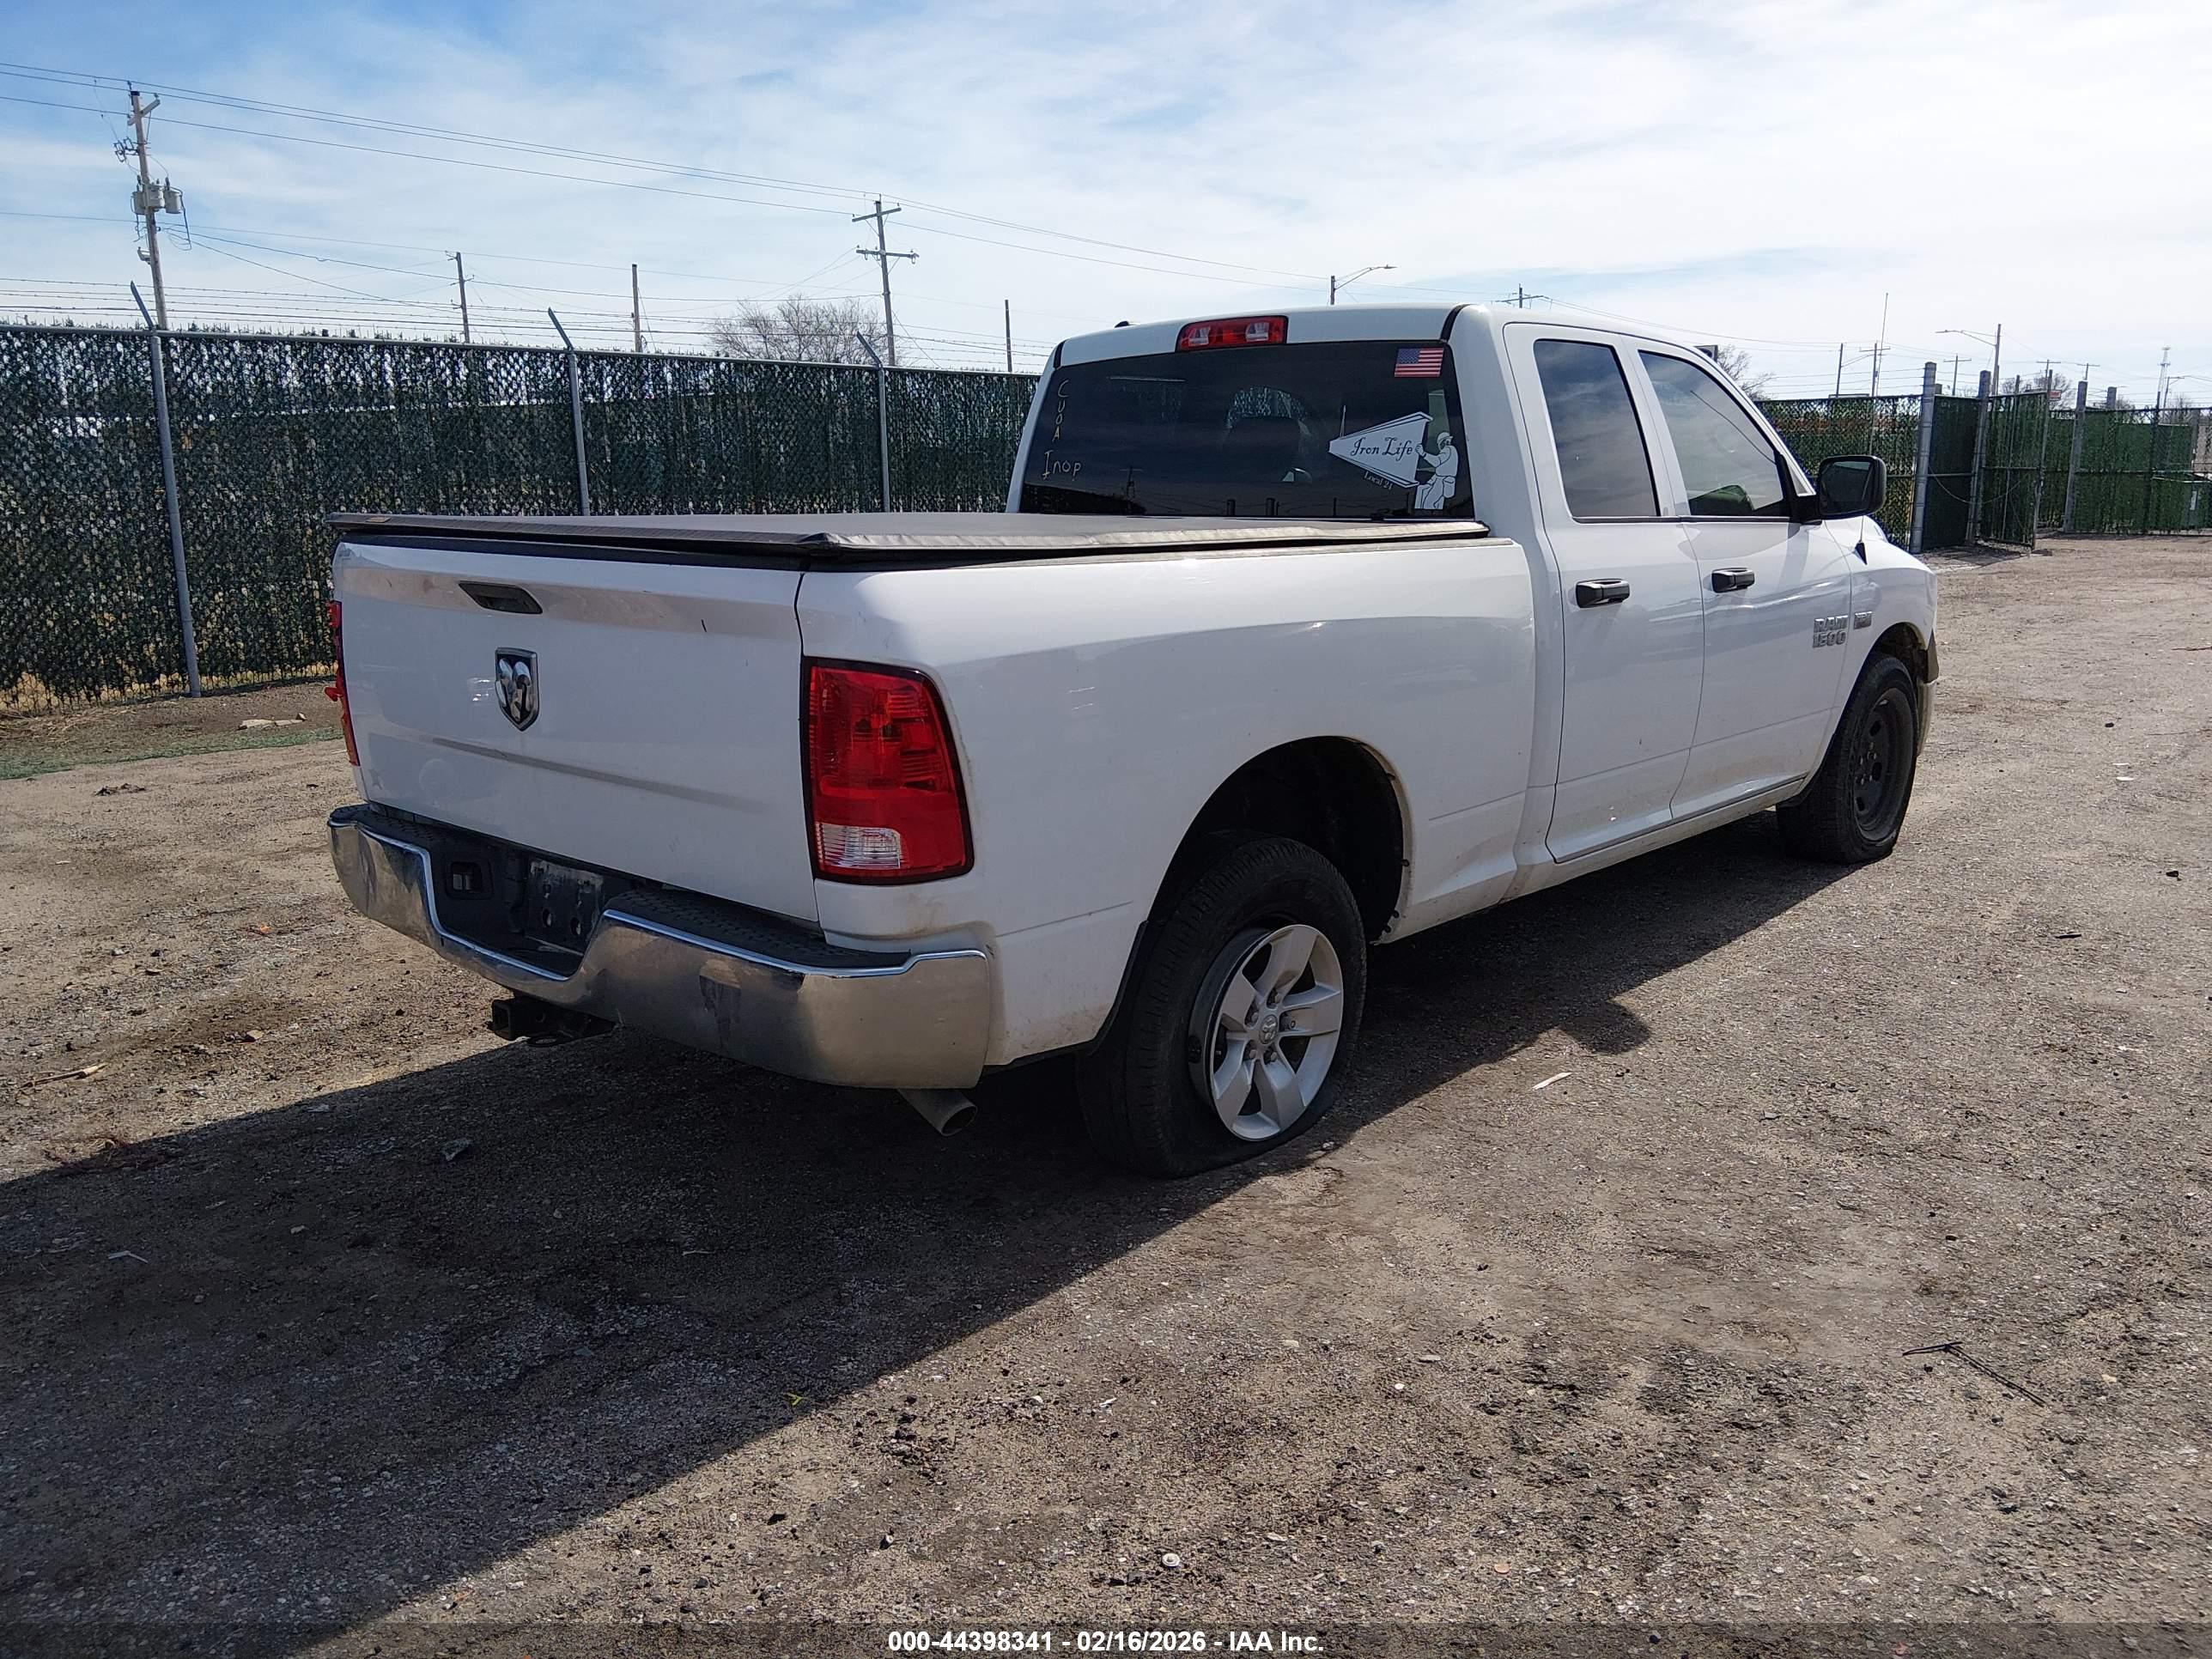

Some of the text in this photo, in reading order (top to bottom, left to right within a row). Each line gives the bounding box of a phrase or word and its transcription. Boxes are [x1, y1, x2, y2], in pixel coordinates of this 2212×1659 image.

[1351, 437, 1413, 462] Iron Life
[1042, 450, 1081, 481] Inop
[1364, 471, 1384, 486] Local
[1813, 615, 1849, 633] RAM
[1813, 630, 1847, 647] 1500
